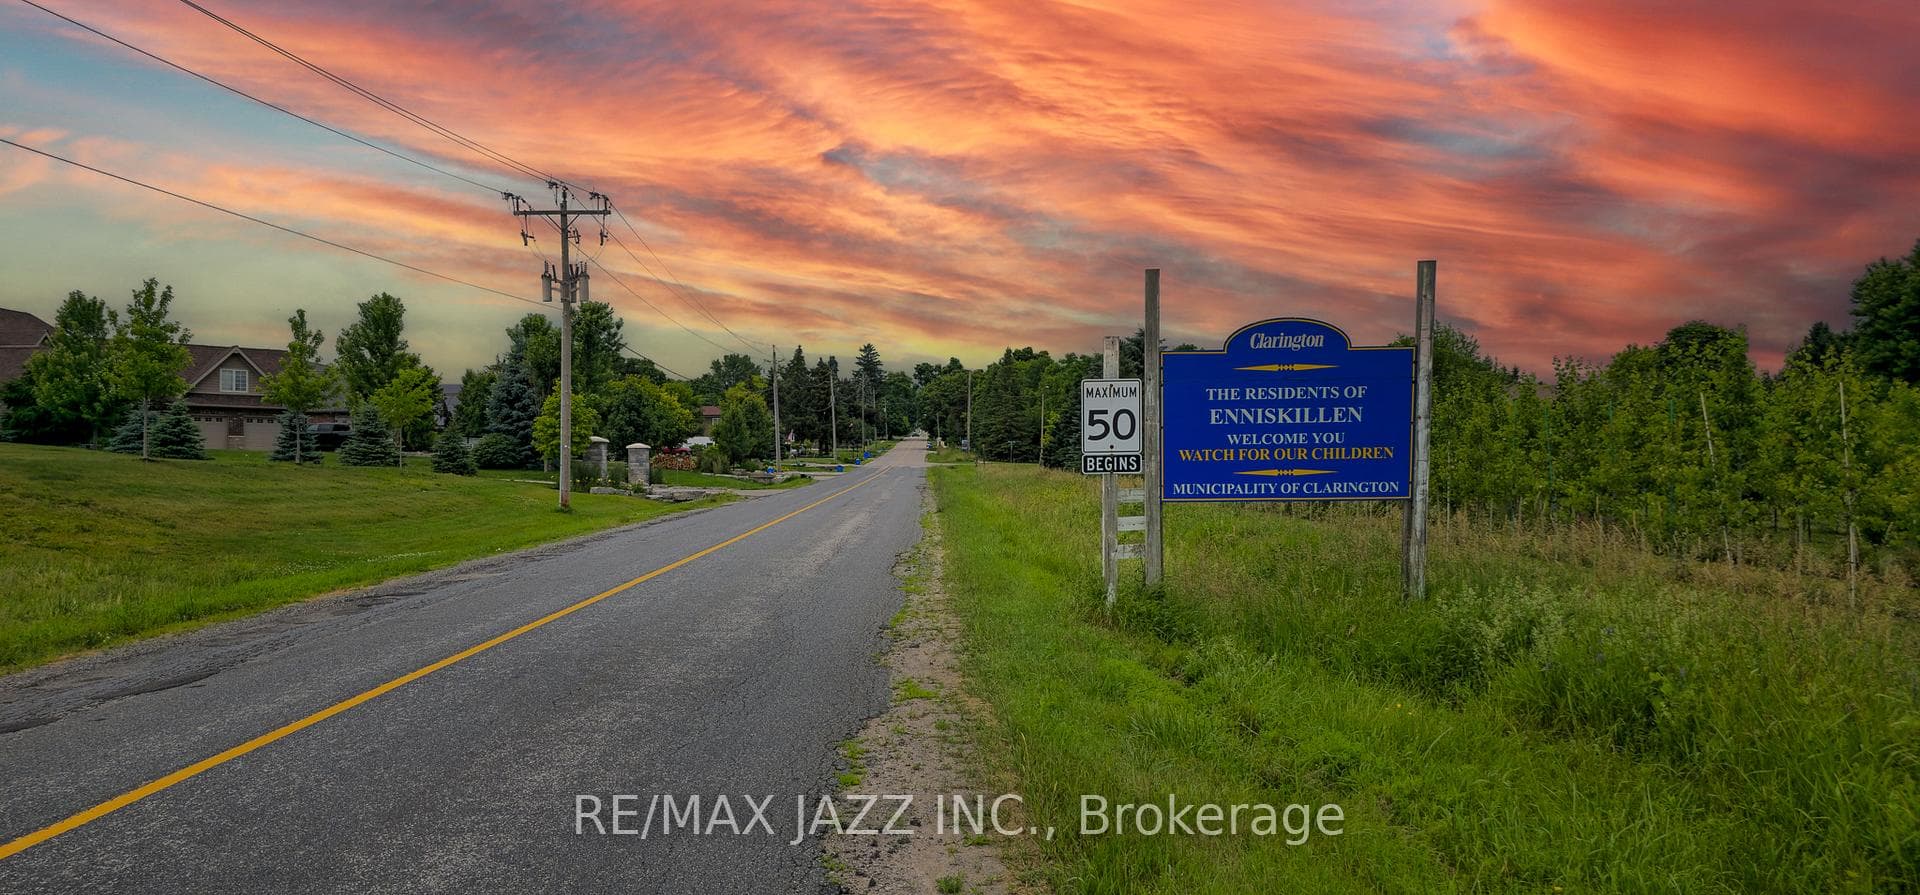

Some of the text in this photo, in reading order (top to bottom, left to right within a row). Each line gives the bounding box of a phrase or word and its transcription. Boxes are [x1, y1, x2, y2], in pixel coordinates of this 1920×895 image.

[1250, 332, 1325, 351] Clarington
[1085, 386, 1138, 399] MAXIMUM
[1206, 386, 1368, 401] THE RESIDENTS OF
[1209, 406, 1363, 425] ENNISKILLEN
[1087, 409, 1136, 441] 50
[1227, 432, 1345, 445] WELCOME YOU
[1179, 446, 1395, 461] WATCH FOR OUR CHILDREN
[1086, 456, 1137, 471] BEGINS
[1173, 481, 1399, 495] MUNICIPALITY OF CLARINGTON
